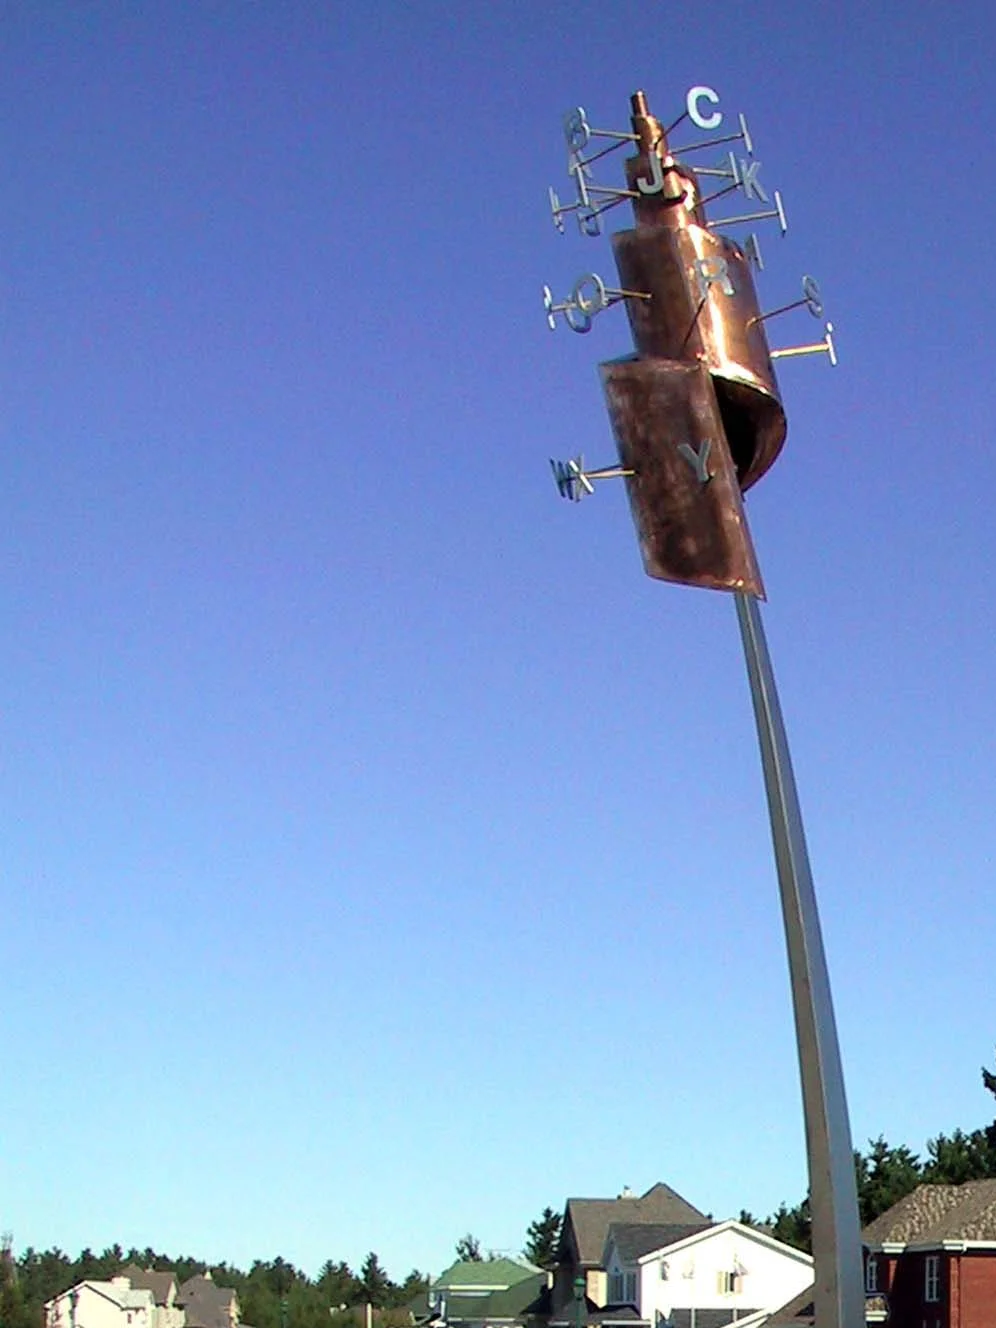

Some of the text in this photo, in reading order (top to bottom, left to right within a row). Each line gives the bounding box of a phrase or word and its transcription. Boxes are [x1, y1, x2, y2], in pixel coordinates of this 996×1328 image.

[686, 85, 723, 130] C
[636, 150, 665, 195] J
[739, 158, 769, 204] K
[677, 438, 712, 483] Y
